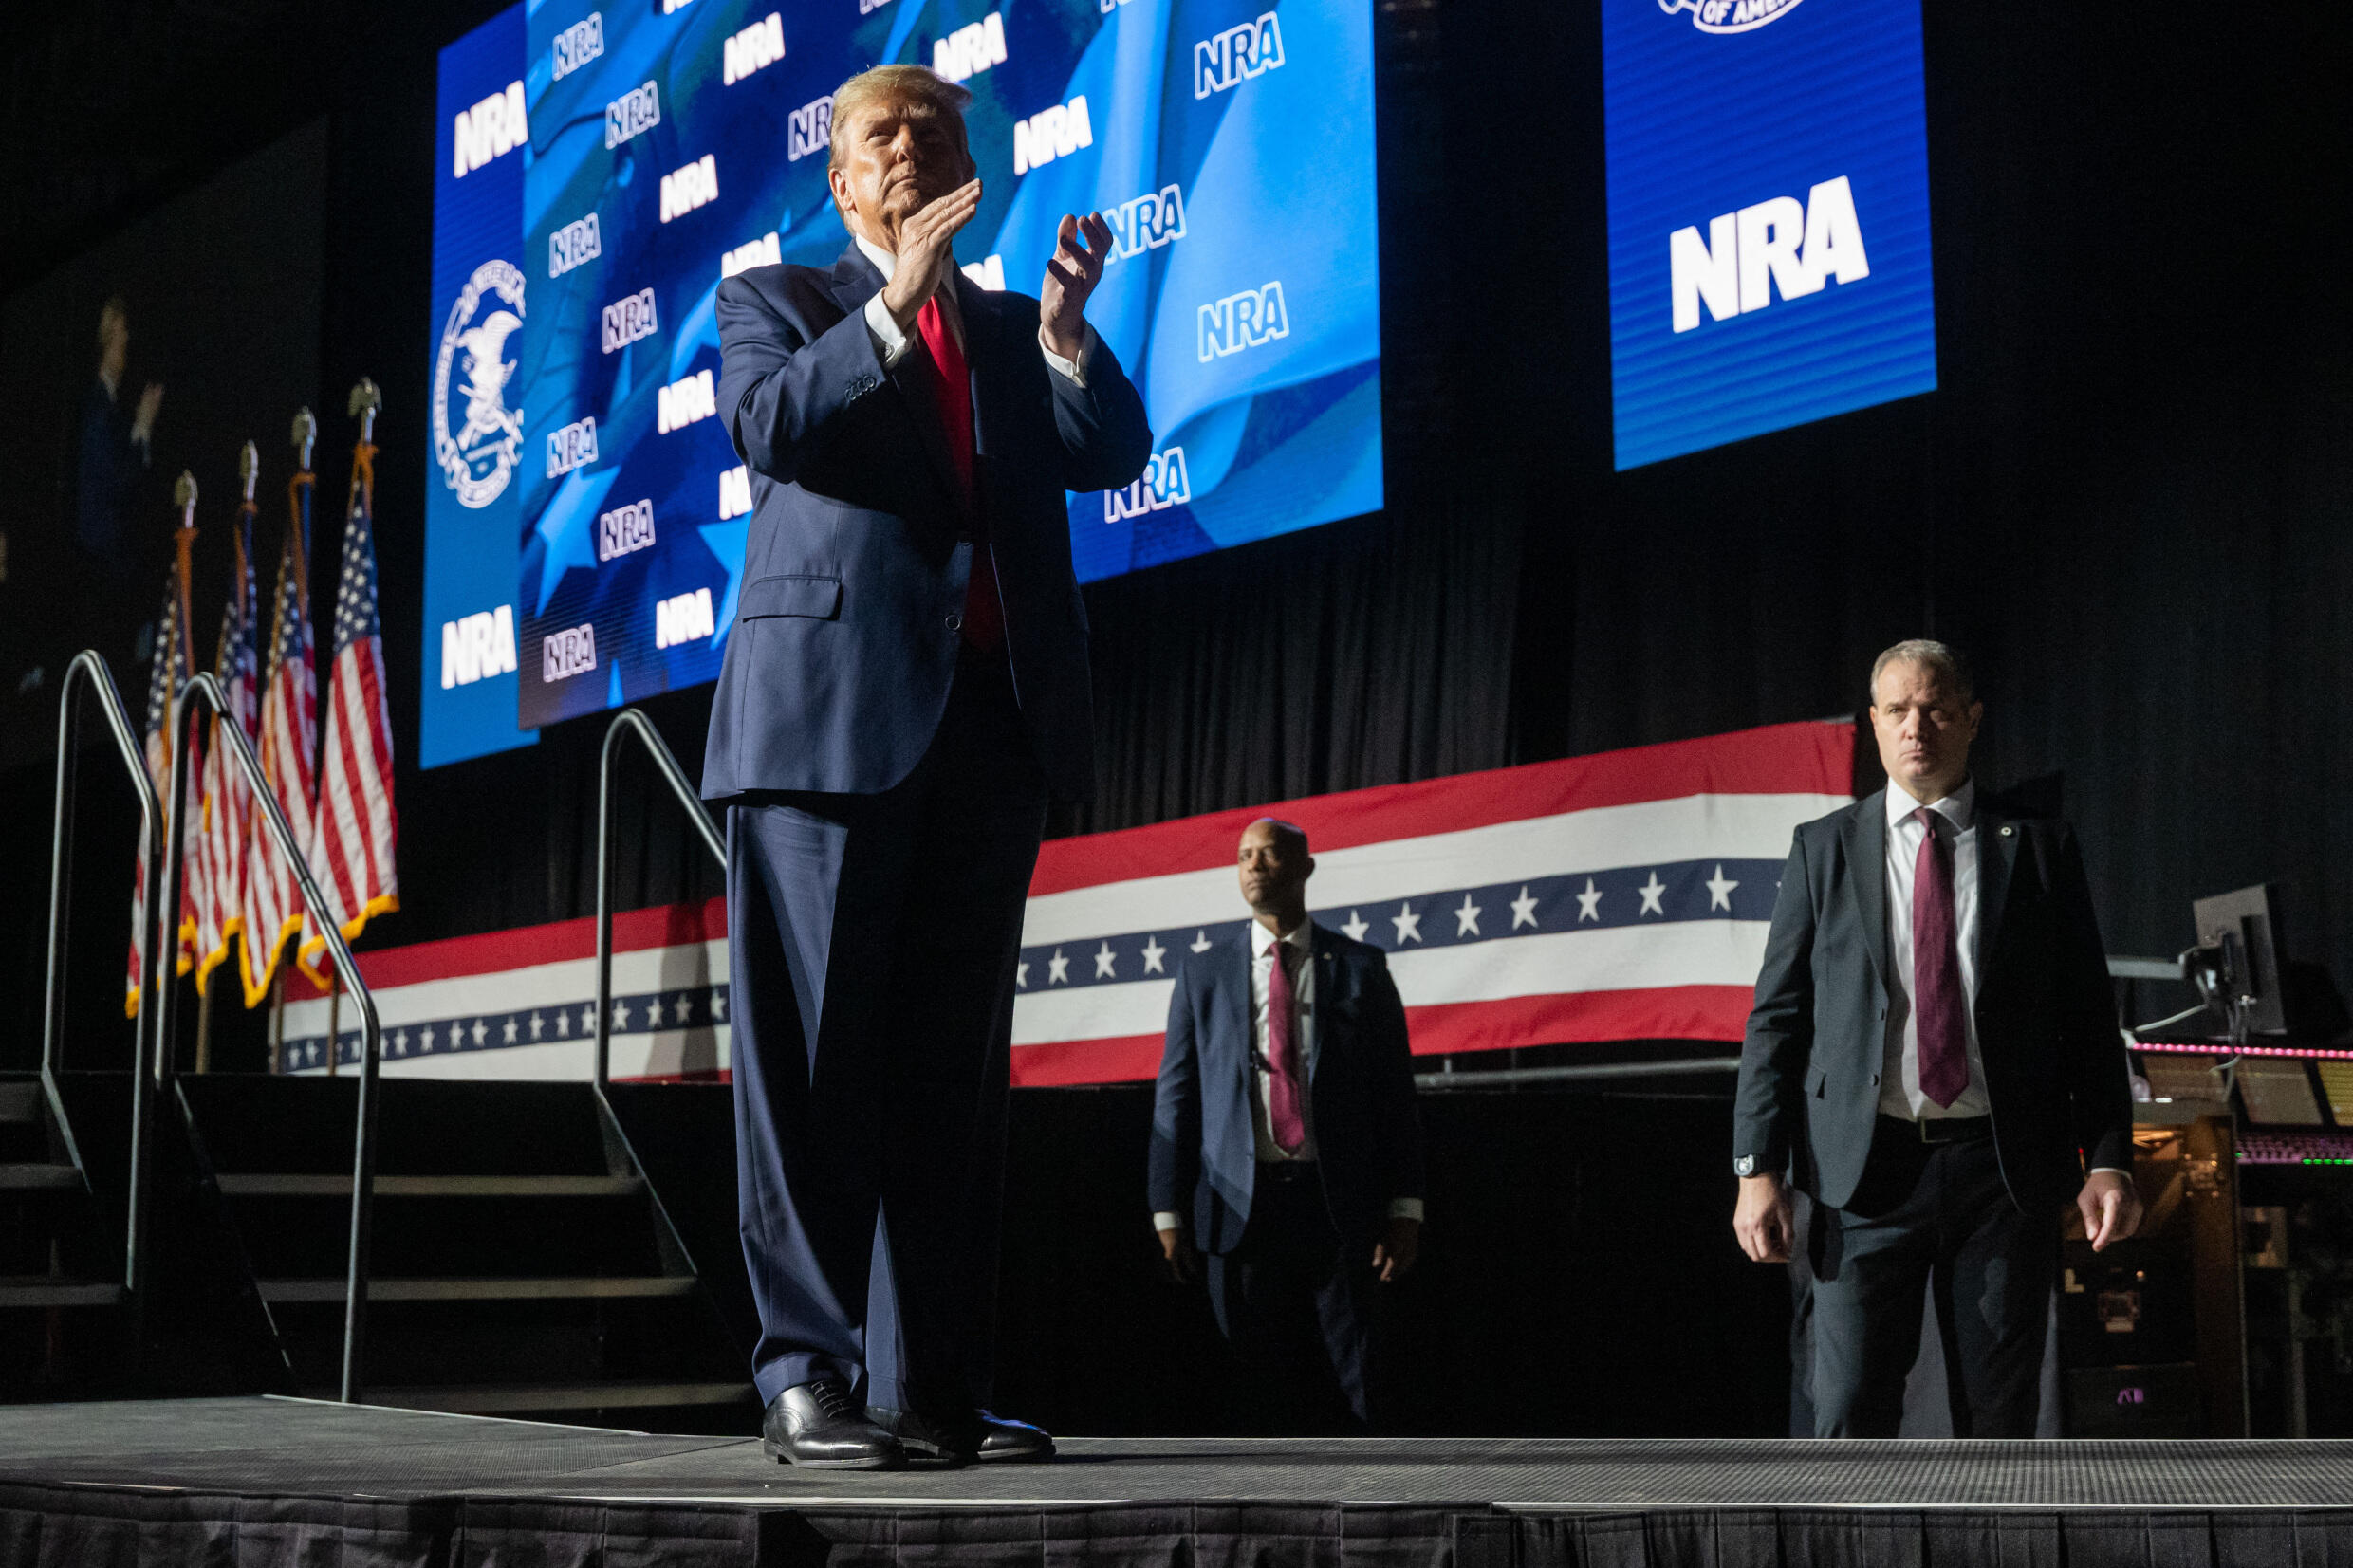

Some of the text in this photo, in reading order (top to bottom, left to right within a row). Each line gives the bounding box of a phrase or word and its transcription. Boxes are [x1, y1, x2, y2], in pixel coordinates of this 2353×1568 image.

[552, 11, 605, 82] NRA
[933, 11, 1008, 83] NRA
[1703, 0, 1732, 25] OF
[724, 11, 786, 86] NRA
[1194, 10, 1286, 100] NRA
[454, 80, 529, 178] NRA
[604, 79, 661, 150] NRA
[787, 95, 832, 162] NR
[1013, 94, 1094, 176] NRA
[659, 153, 719, 224] NRA
[548, 212, 602, 279] NRA
[1669, 175, 1870, 334] NRA
[601, 286, 658, 355] NRA
[1197, 280, 1289, 363] NRA
[657, 368, 716, 435] NRA
[546, 415, 600, 480] NRA
[599, 497, 657, 563] NRA
[441, 603, 518, 690] NRA
[542, 622, 597, 684] NRA
[655, 587, 715, 650] NRA
